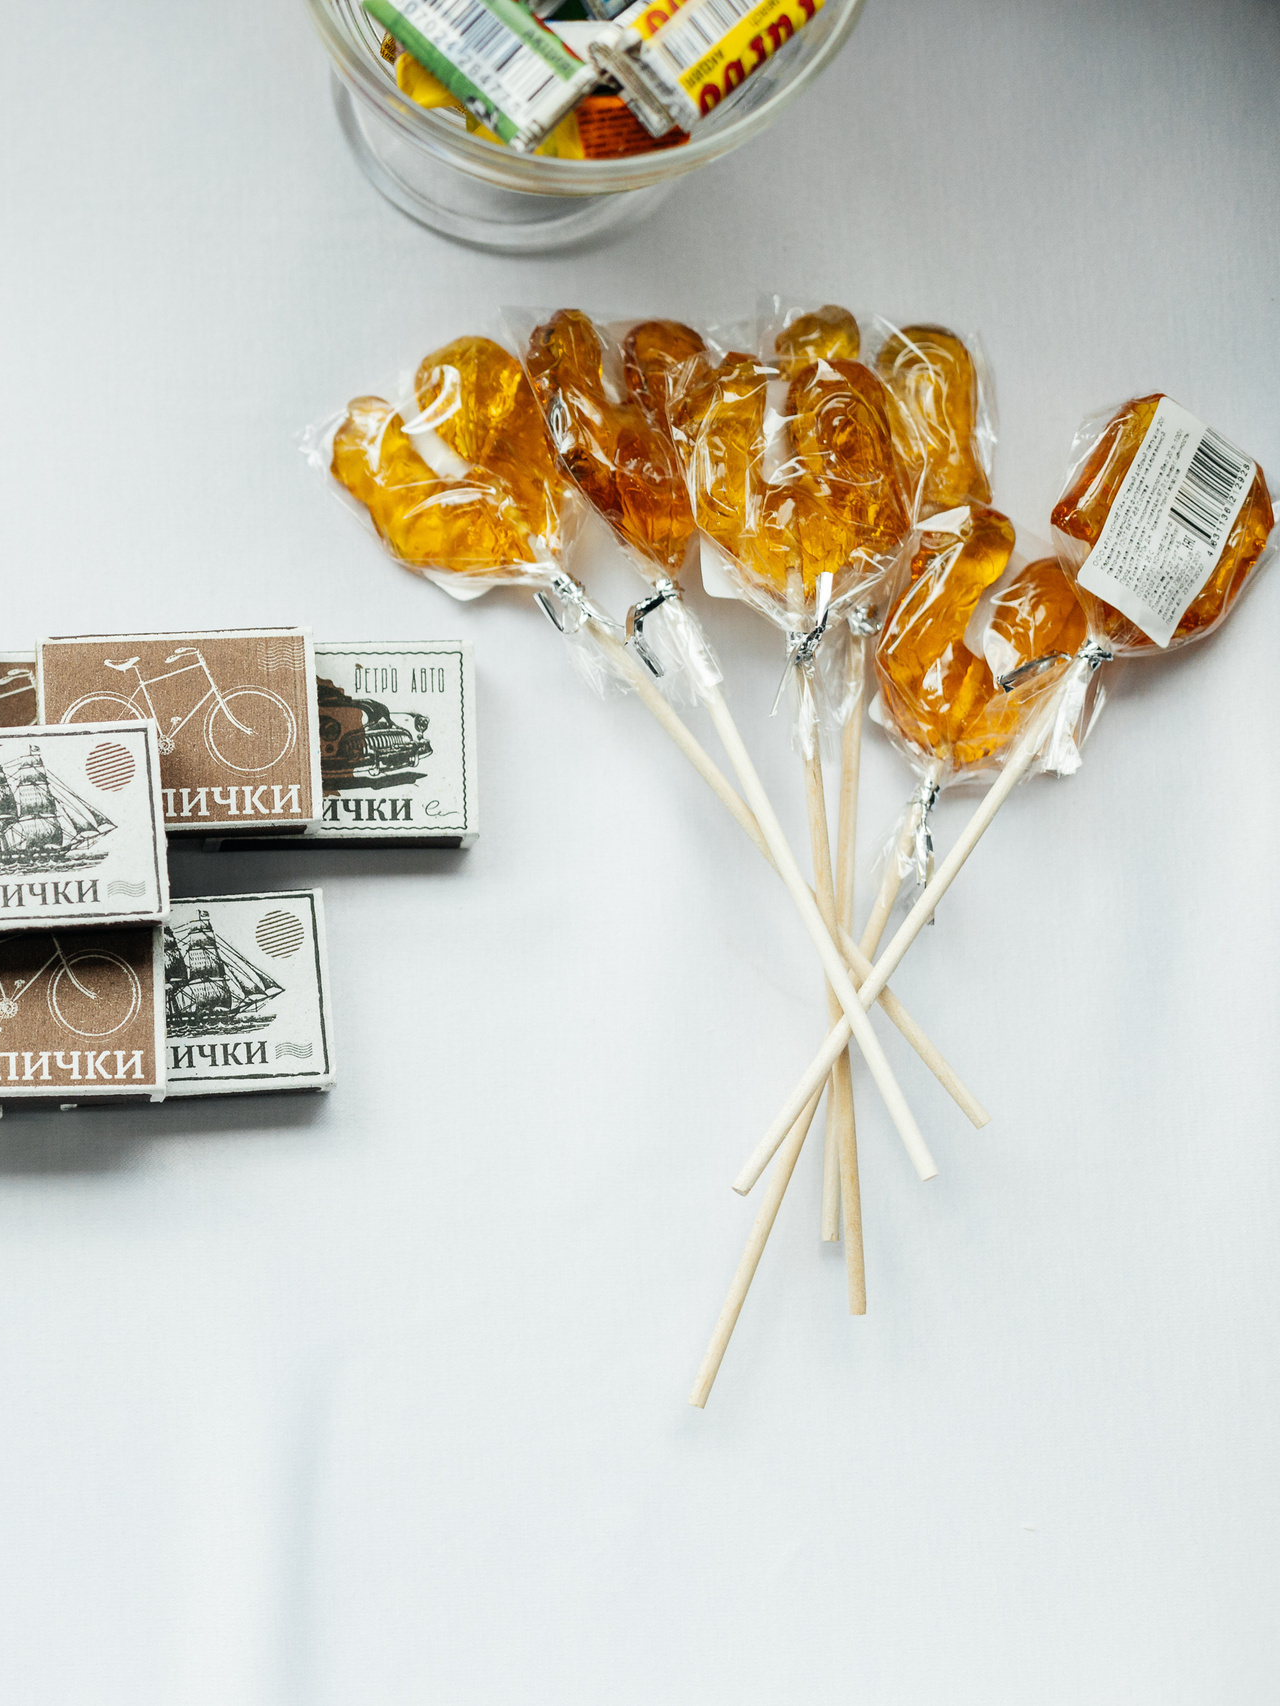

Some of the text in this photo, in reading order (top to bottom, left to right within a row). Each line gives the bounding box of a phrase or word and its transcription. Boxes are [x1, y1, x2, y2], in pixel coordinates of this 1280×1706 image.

[411, 667, 445, 693] АВТО
[322, 798, 413, 821] ИЧКИ
[167, 1040, 268, 1070] ИЧКИ
